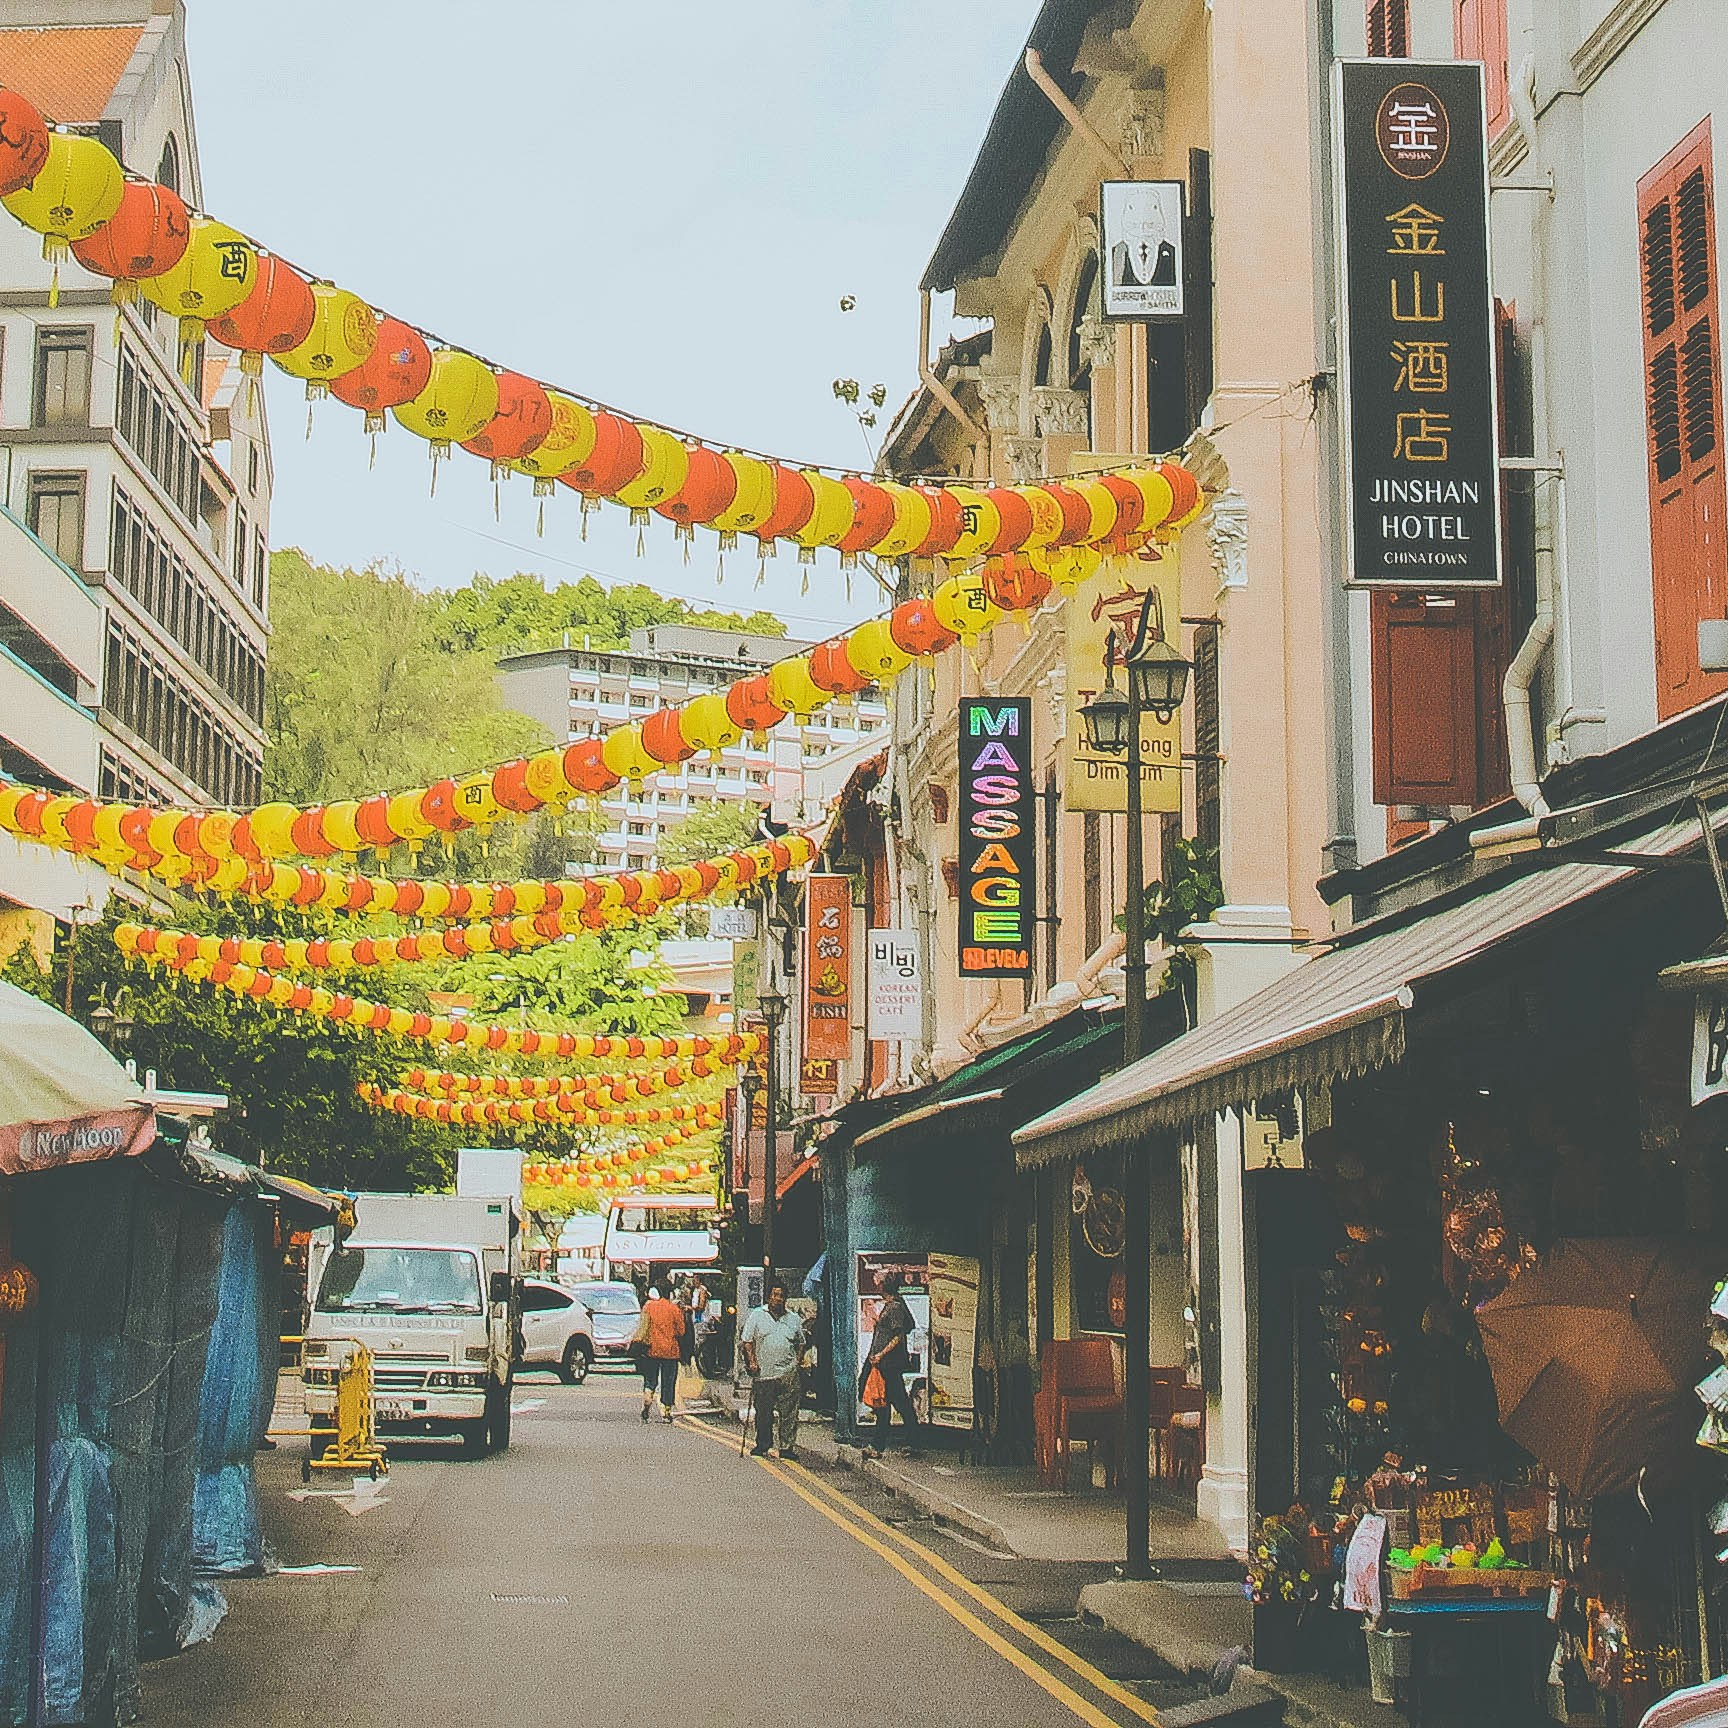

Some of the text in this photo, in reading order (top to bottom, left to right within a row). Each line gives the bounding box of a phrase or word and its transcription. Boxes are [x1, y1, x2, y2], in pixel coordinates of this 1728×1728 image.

[1384, 201, 1453, 462] 金山酒店
[1369, 478, 1480, 505] JINSHAN
[1381, 515, 1471, 541] HOTEL
[1383, 550, 1468, 567] CHINATOWN
[1139, 737, 1173, 758] ong
[1087, 761, 1120, 780] Dim
[968, 705, 1022, 944] MASSAGE
[874, 941, 915, 978] 비빙
[879, 983, 918, 993] KOREAN
